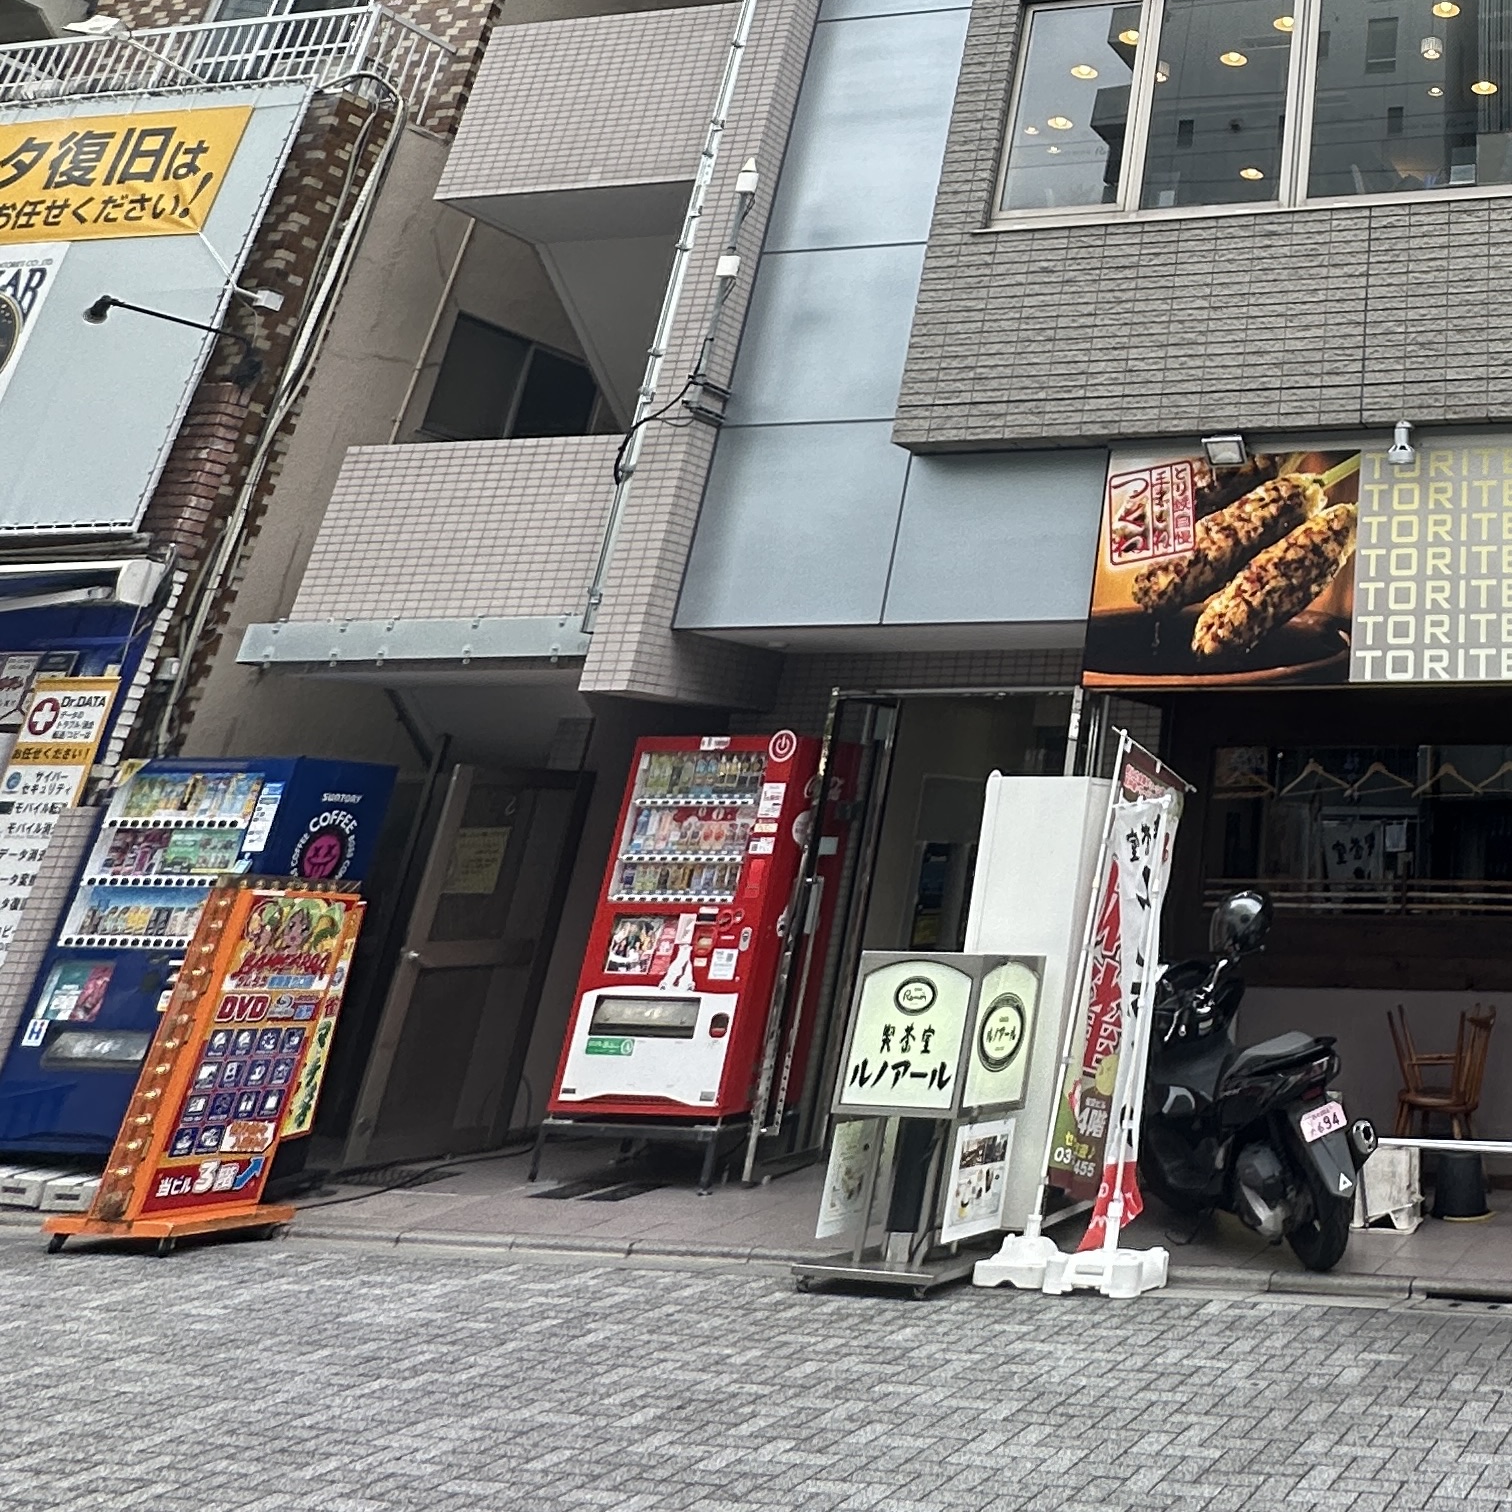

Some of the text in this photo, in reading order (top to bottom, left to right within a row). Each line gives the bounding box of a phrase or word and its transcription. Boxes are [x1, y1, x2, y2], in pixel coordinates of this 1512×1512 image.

[1112, 477, 1150, 558] つくね
[308, 809, 358, 835] COFFEE
[214, 994, 269, 1022] DVD
[880, 1022, 936, 1054] 喫茶室
[985, 1026, 1017, 1043] ルノアール
[850, 1058, 953, 1091] ルノアール
